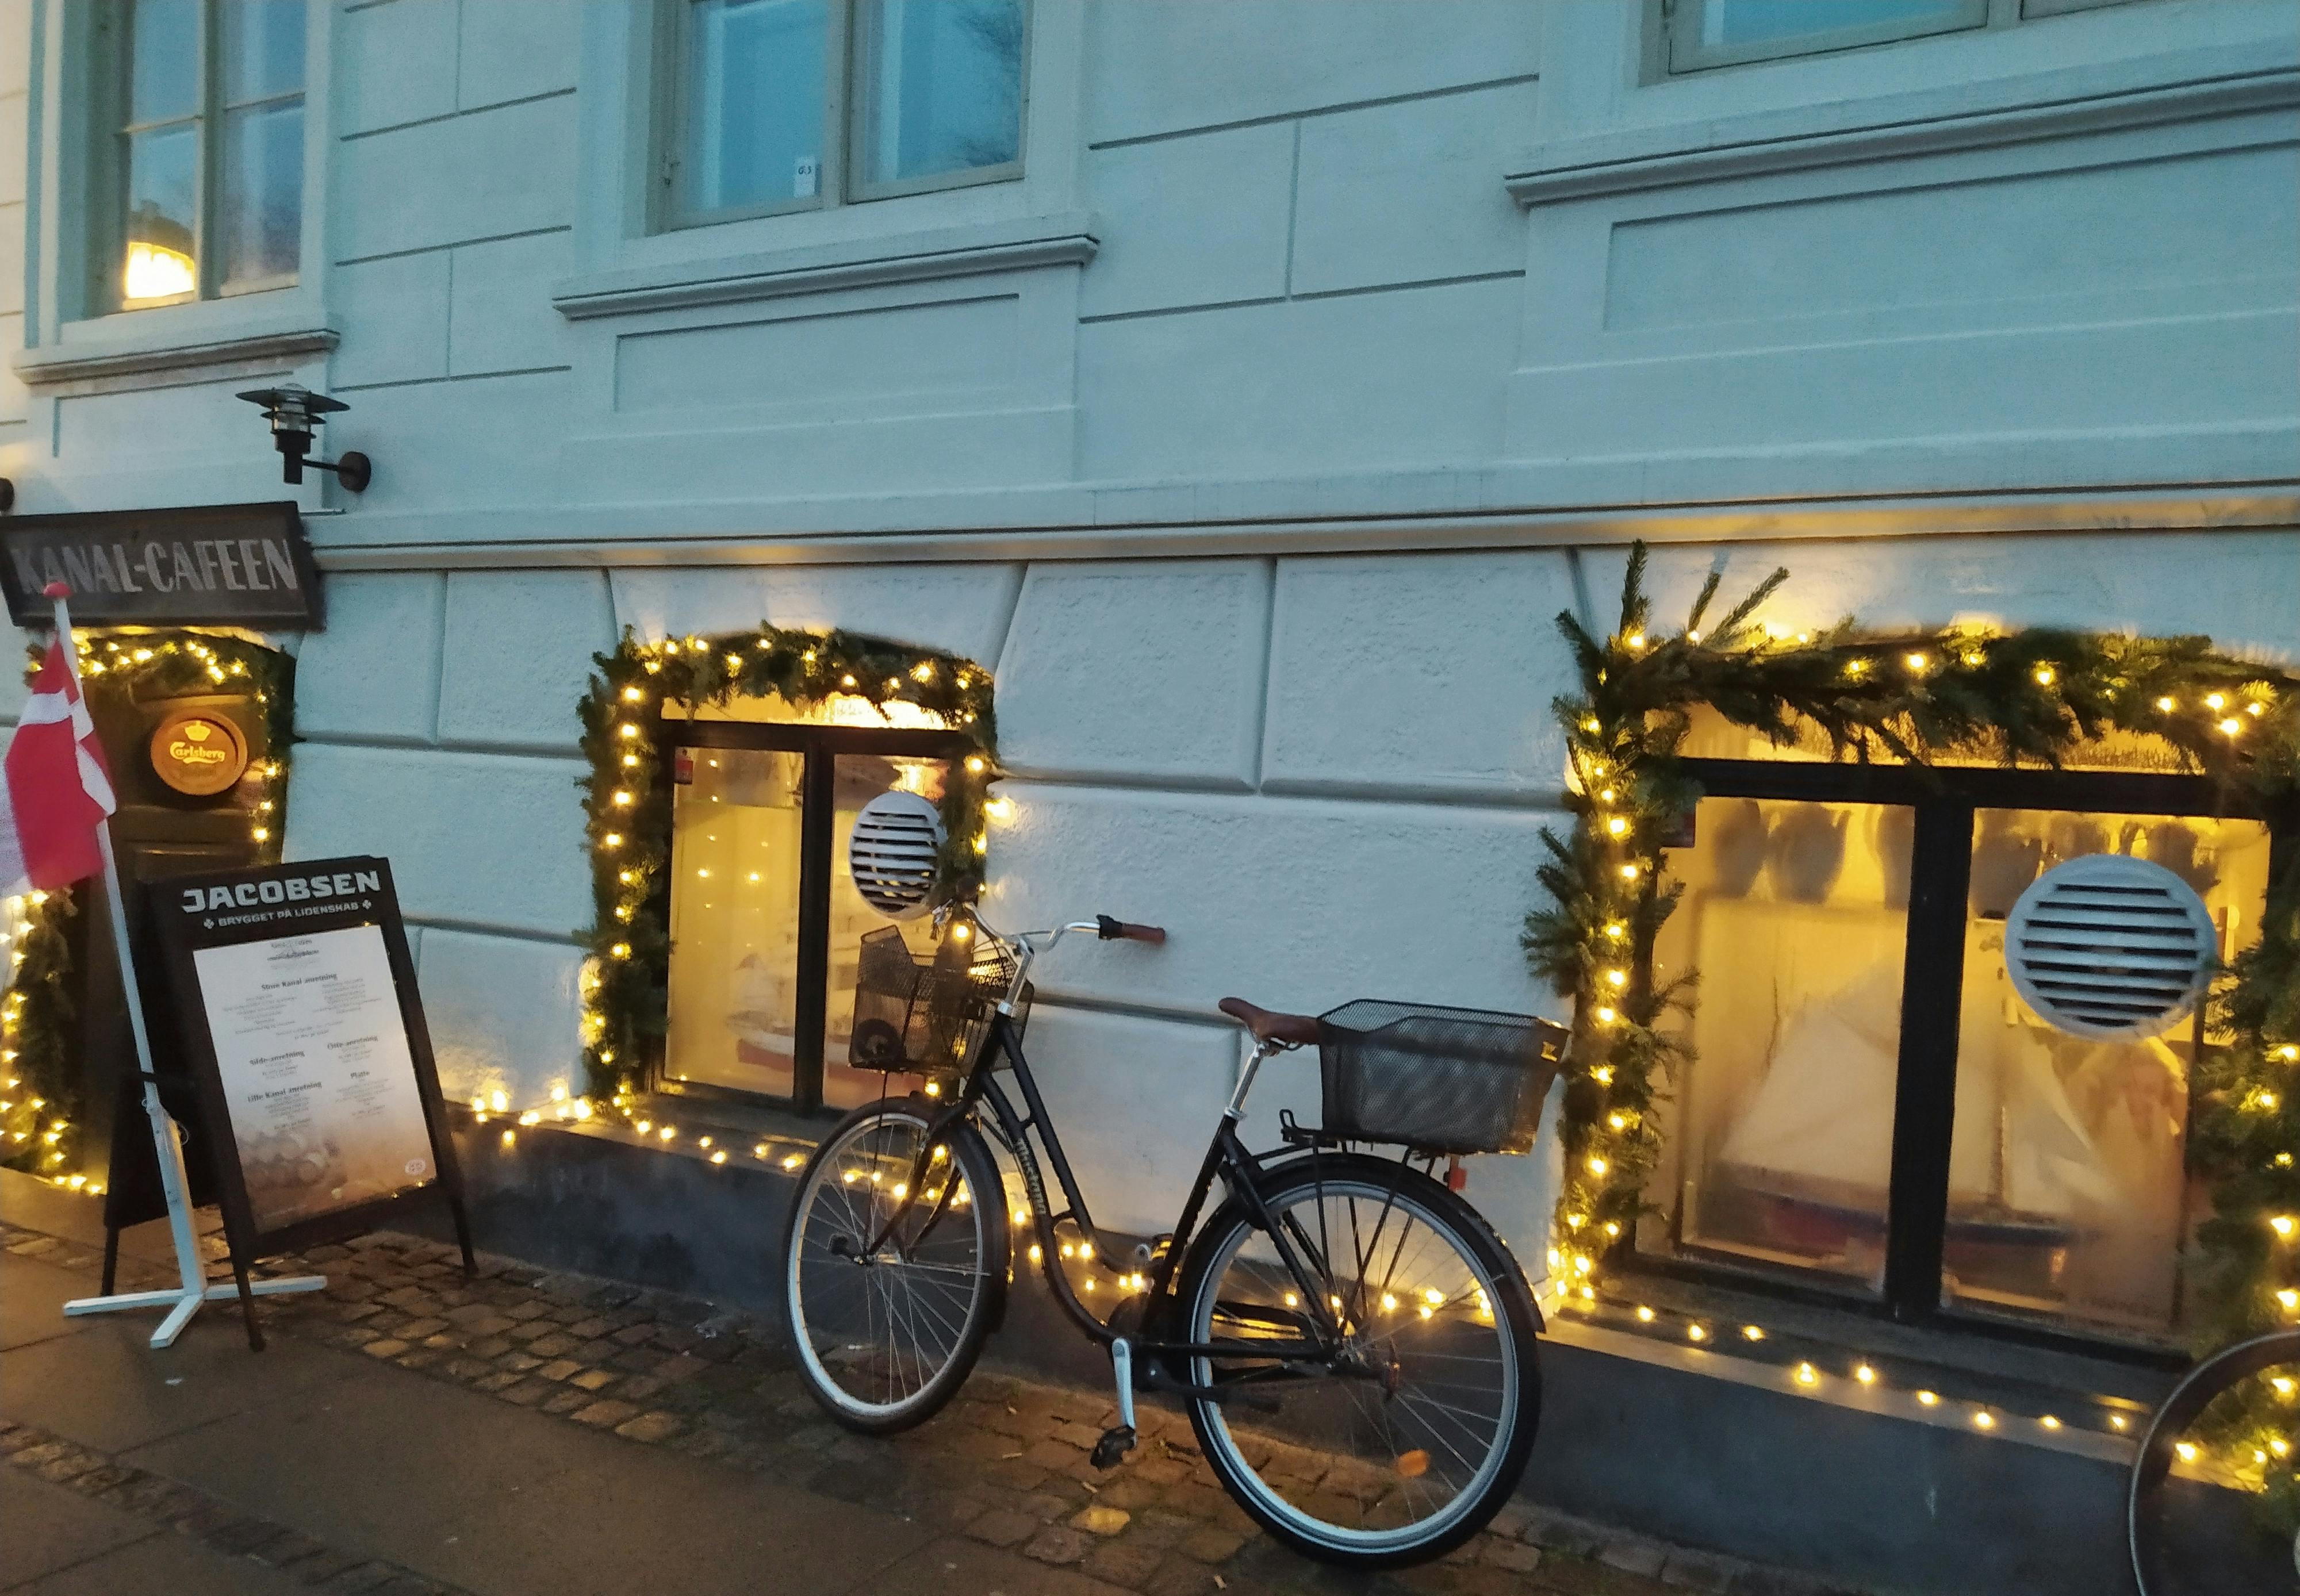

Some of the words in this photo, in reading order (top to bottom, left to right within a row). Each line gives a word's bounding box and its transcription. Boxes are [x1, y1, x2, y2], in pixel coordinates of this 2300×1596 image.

[170, 742, 226, 764] Carlsberg
[182, 870, 381, 913] JACOBSEN
[218, 912, 274, 927] BRYGGET
[294, 903, 359, 918] LIDENSKAB
